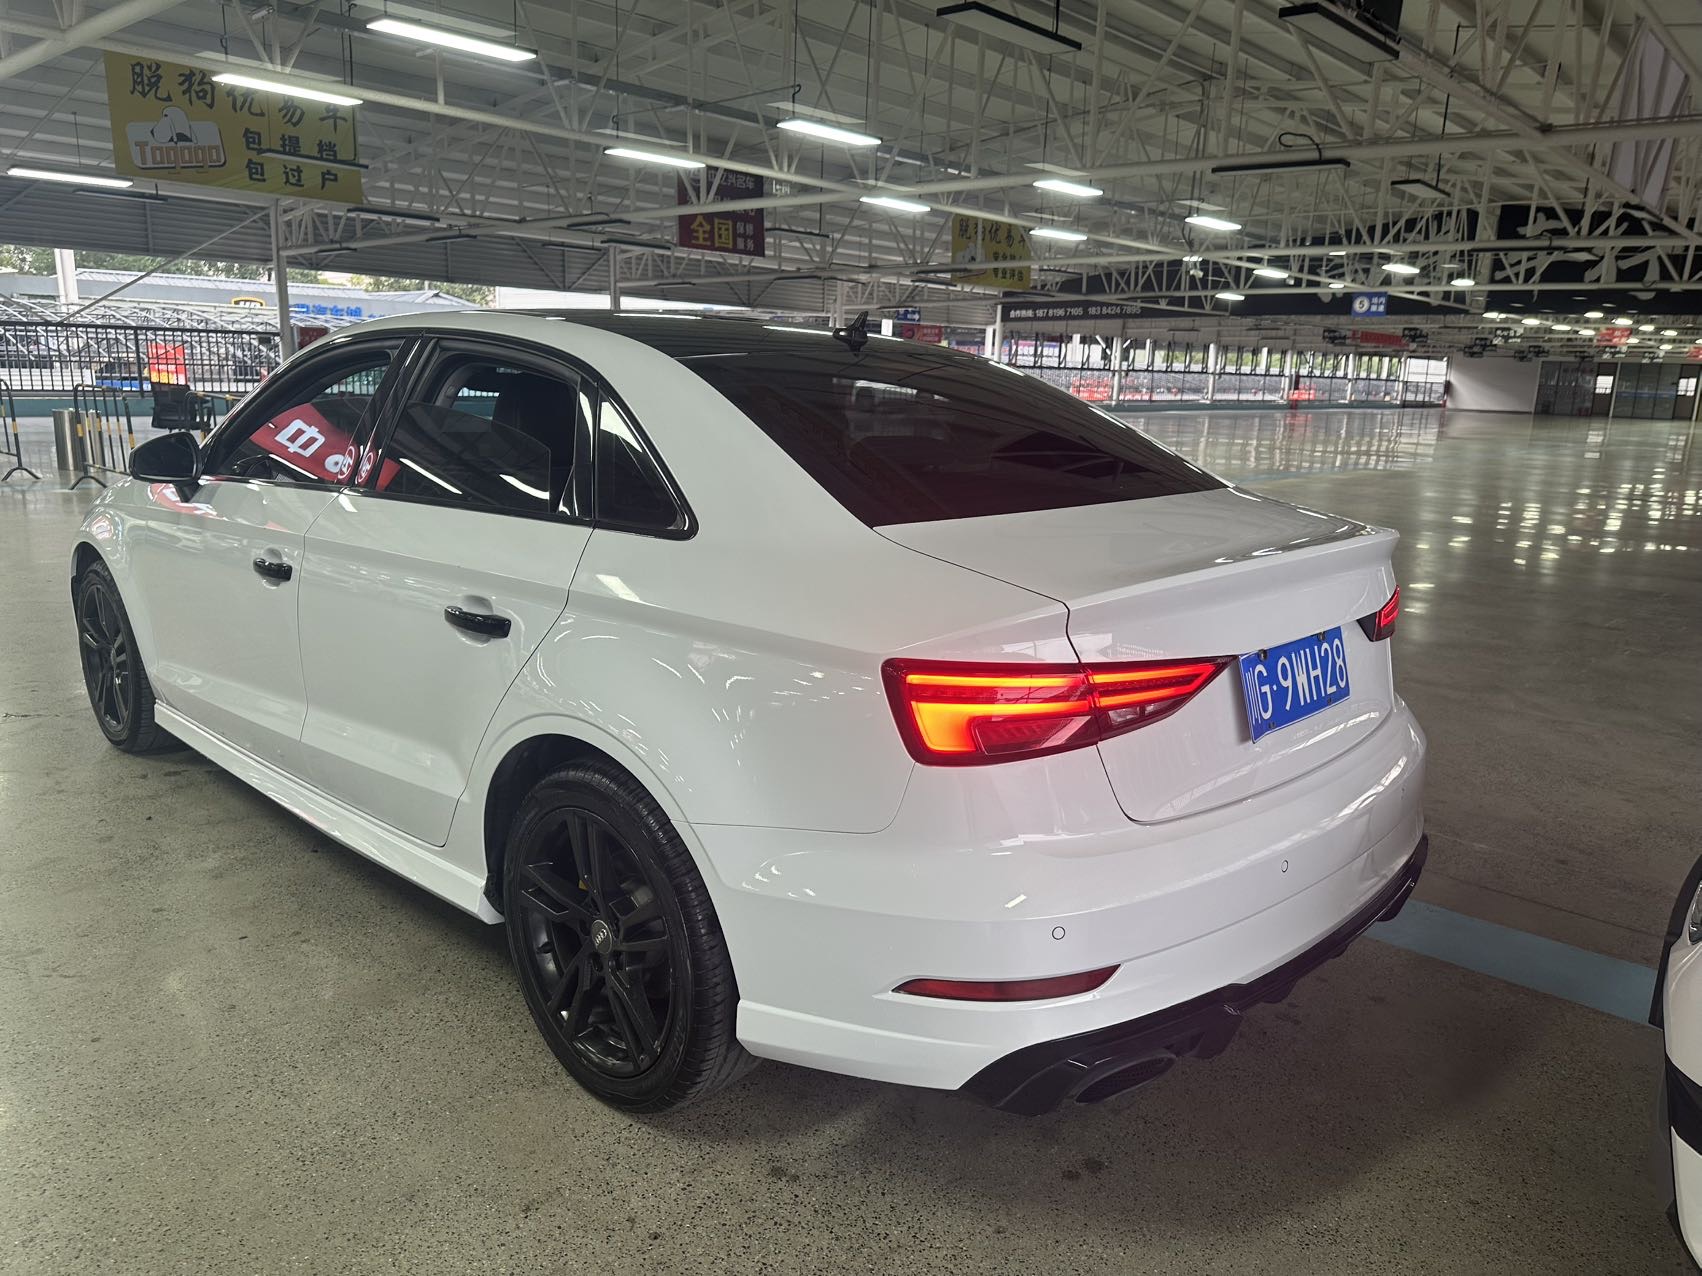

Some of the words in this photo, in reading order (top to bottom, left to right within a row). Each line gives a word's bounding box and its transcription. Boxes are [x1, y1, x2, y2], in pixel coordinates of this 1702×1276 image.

[245, 158, 338, 191] 包过户
[690, 214, 733, 249] 全国
